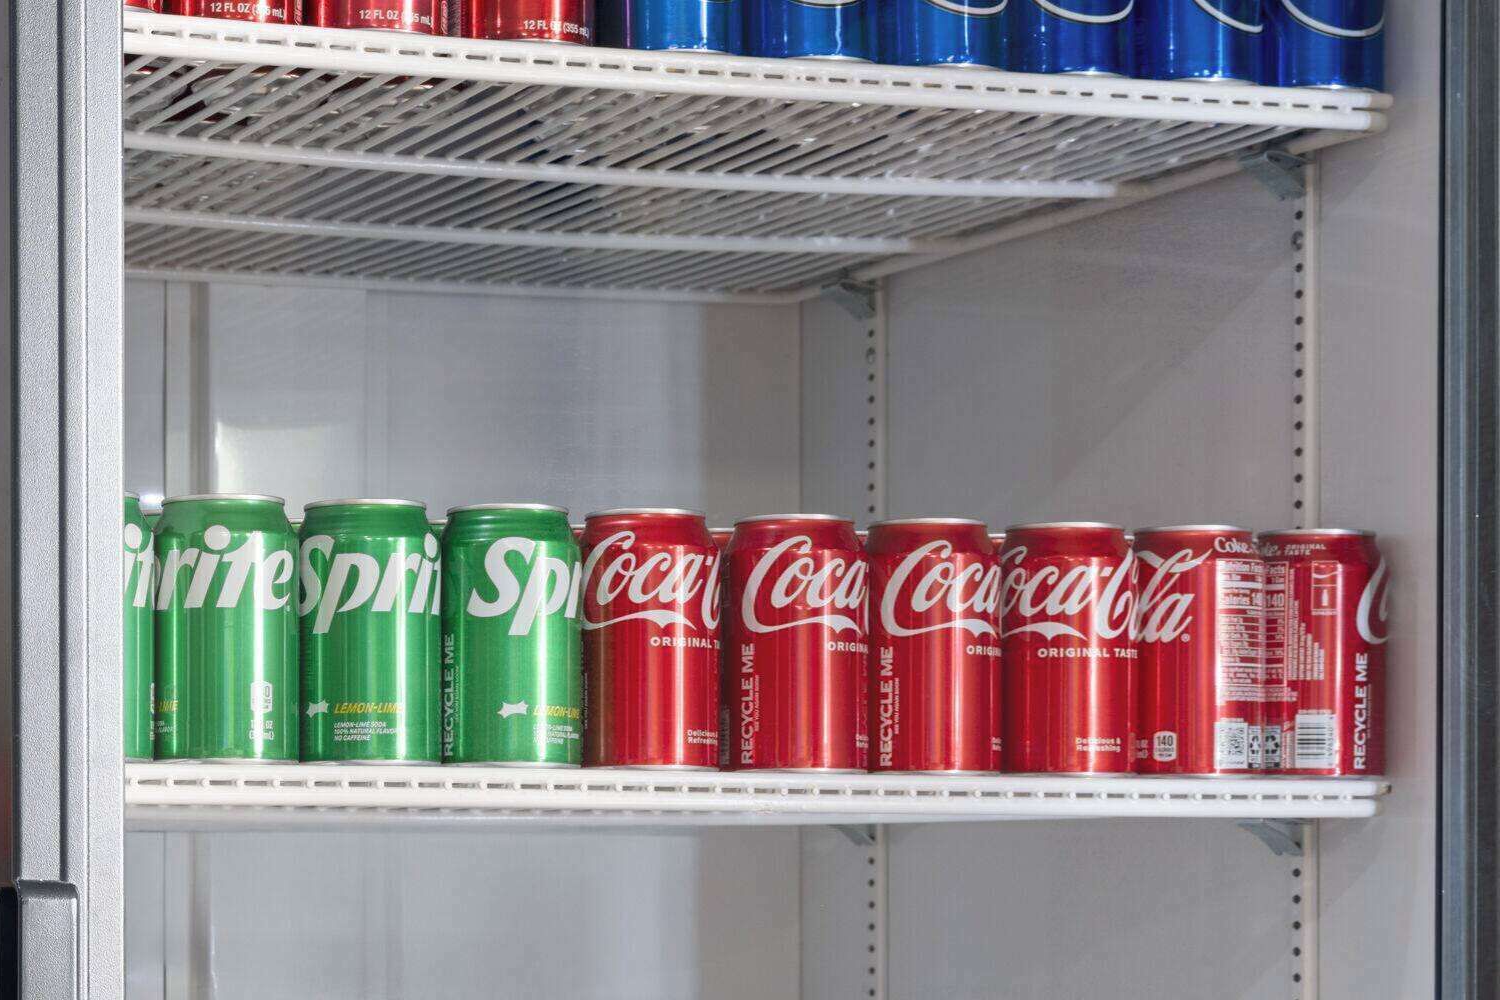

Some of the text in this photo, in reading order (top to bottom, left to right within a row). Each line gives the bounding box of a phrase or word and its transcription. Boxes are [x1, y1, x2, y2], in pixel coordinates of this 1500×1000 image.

[359, 9, 371, 19] 12
[373, 10, 385, 20] FL
[523, 20, 536, 30] 12
[650, 637, 712, 648] ORIGINAL
[1038, 648, 1110, 658] ORIGINAL
[443, 633, 455, 756] RECYCLE ME
[741, 643, 756, 764] RECYCLE ME
[880, 646, 894, 767] RECYCLE ME
[1353, 652, 1368, 770] RECYCLE ME
[1156, 734, 1175, 748] 140
